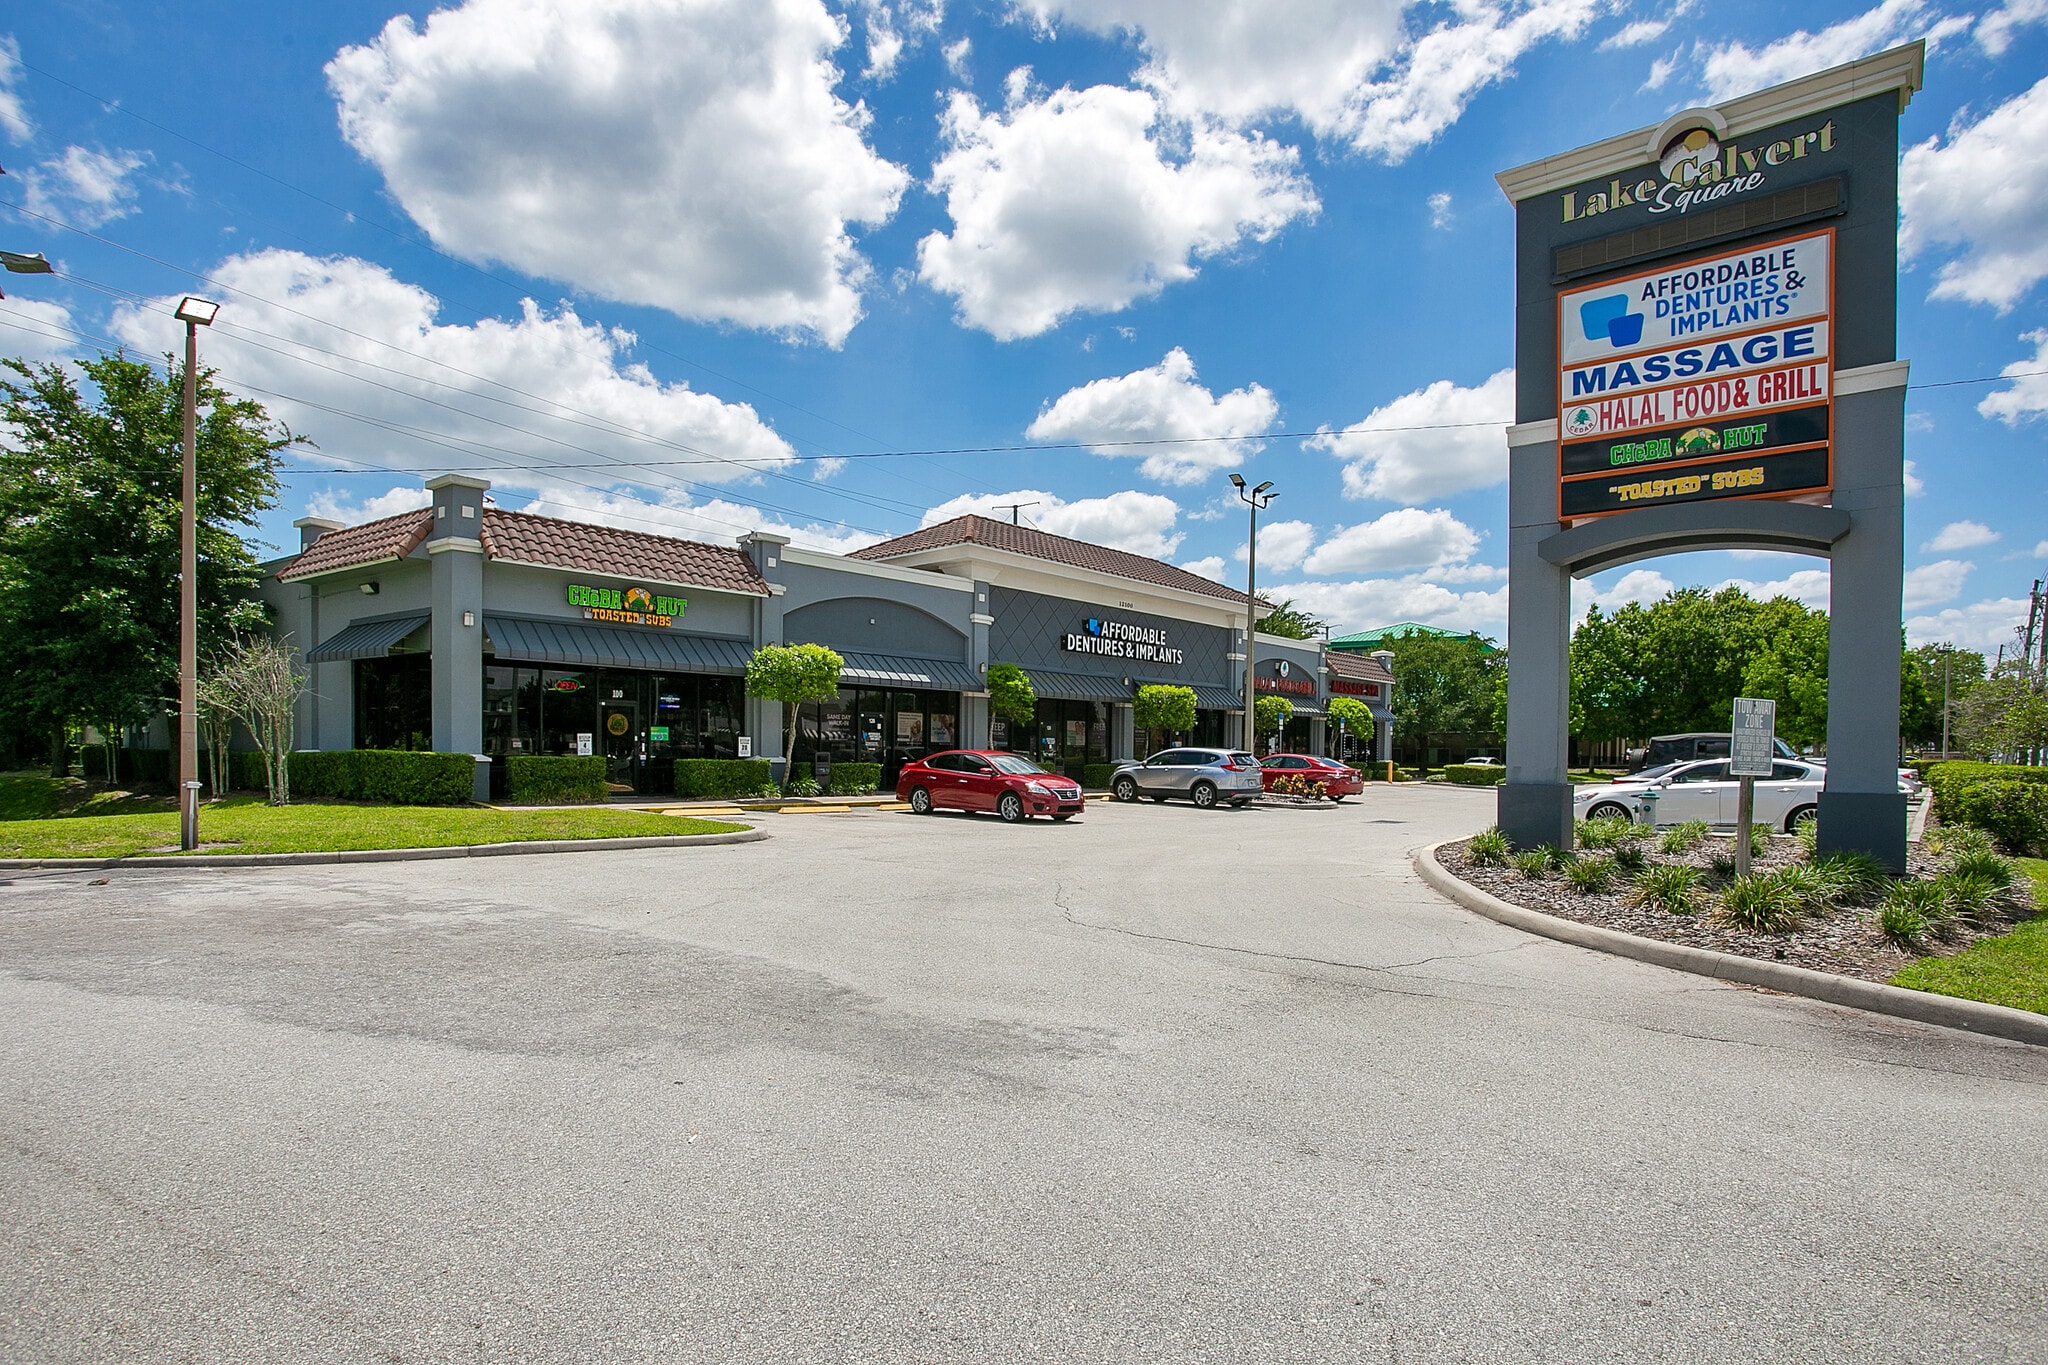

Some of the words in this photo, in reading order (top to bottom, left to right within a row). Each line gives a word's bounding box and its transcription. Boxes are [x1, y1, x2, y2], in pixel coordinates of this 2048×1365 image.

[1561, 177, 1657, 223] Lake
[1669, 119, 1837, 191] Calvert
[1648, 170, 1766, 214] Square
[1641, 248, 1796, 301] AFFORDABLE
[1656, 274, 1779, 318] DENTURES
[1785, 270, 1806, 291] &
[1573, 327, 1815, 396] MASSAGE
[1600, 393, 1665, 431] HALAL
[1758, 367, 1822, 404] GRILL
[1569, 422, 1594, 433] CEDAR
[1723, 424, 1767, 449] HUT
[1712, 467, 1765, 490] SUBS
[657, 596, 687, 617] HUT
[646, 614, 672, 627] SUBS
[1101, 621, 1166, 645] AFFORDABLE
[1067, 634, 1124, 657] DENTURES
[1126, 642, 1134, 658] &
[1136, 643, 1183, 664] IMPLANTS
[555, 681, 578, 690] OPEN
[612, 690, 623, 698] 100
[1737, 701, 1753, 714] TOW
[1754, 702, 1772, 715] AWAY
[994, 722, 1006, 731] EEP
[1745, 714, 1764, 728] ZONE
